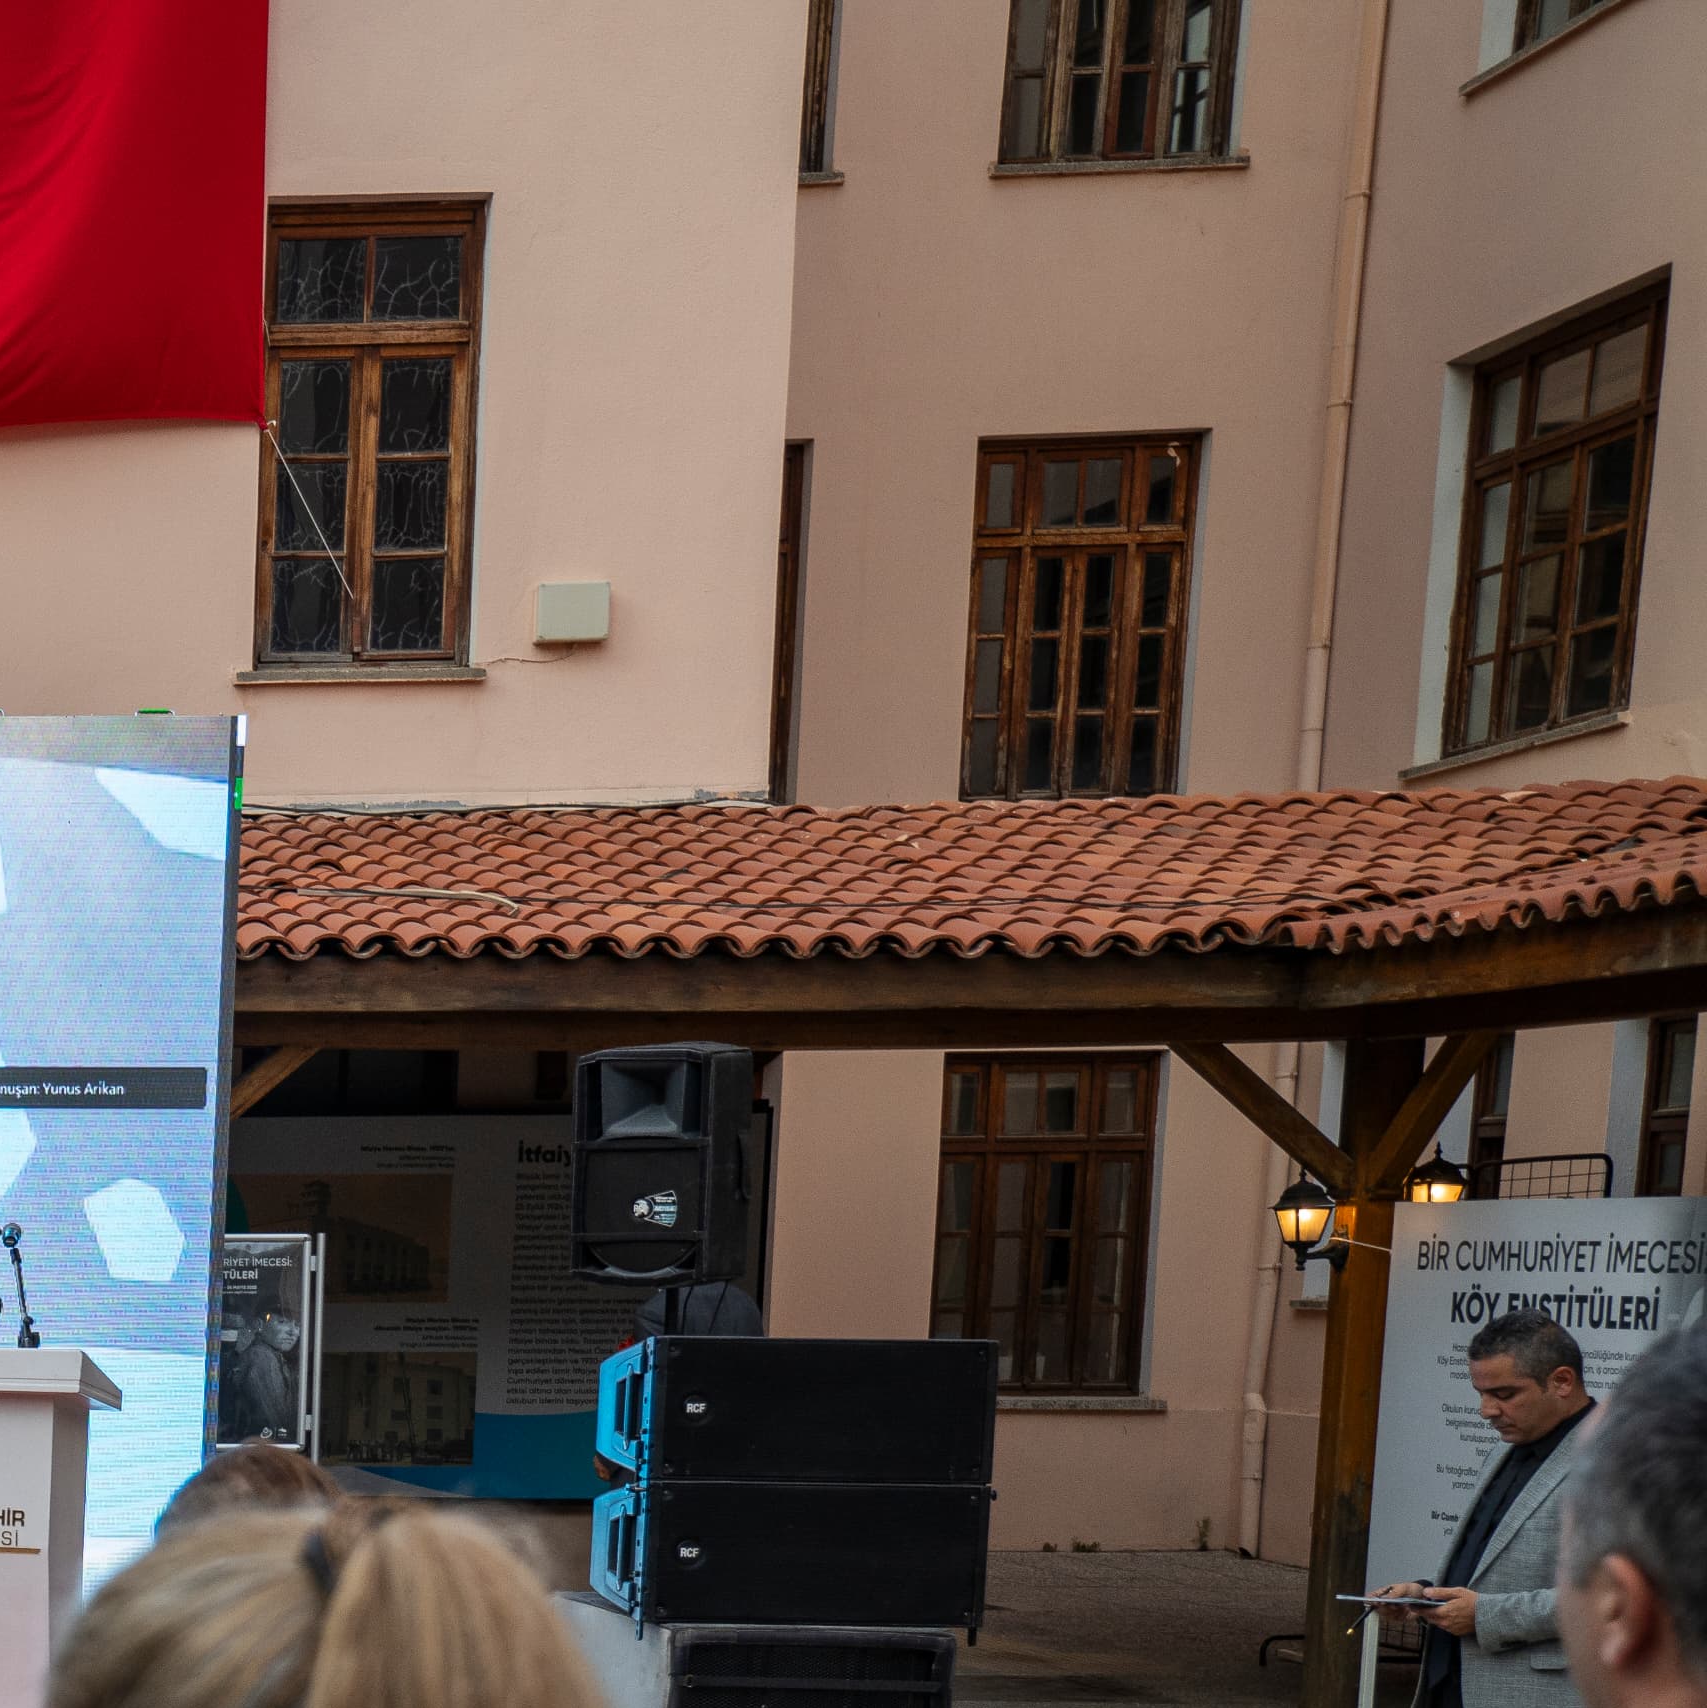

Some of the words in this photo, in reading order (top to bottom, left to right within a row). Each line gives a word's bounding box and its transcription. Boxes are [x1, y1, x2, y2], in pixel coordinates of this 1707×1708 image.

[42, 1082, 81, 1096] Yunus
[517, 1140, 572, 1167] İtfaiy
[1416, 1232, 1451, 1271] BİR
[1455, 1232, 1602, 1273] CUMHURİYET
[1450, 1283, 1501, 1324] KÖY
[686, 1404, 707, 1414] RCF
[680, 1547, 700, 1558] RCF
